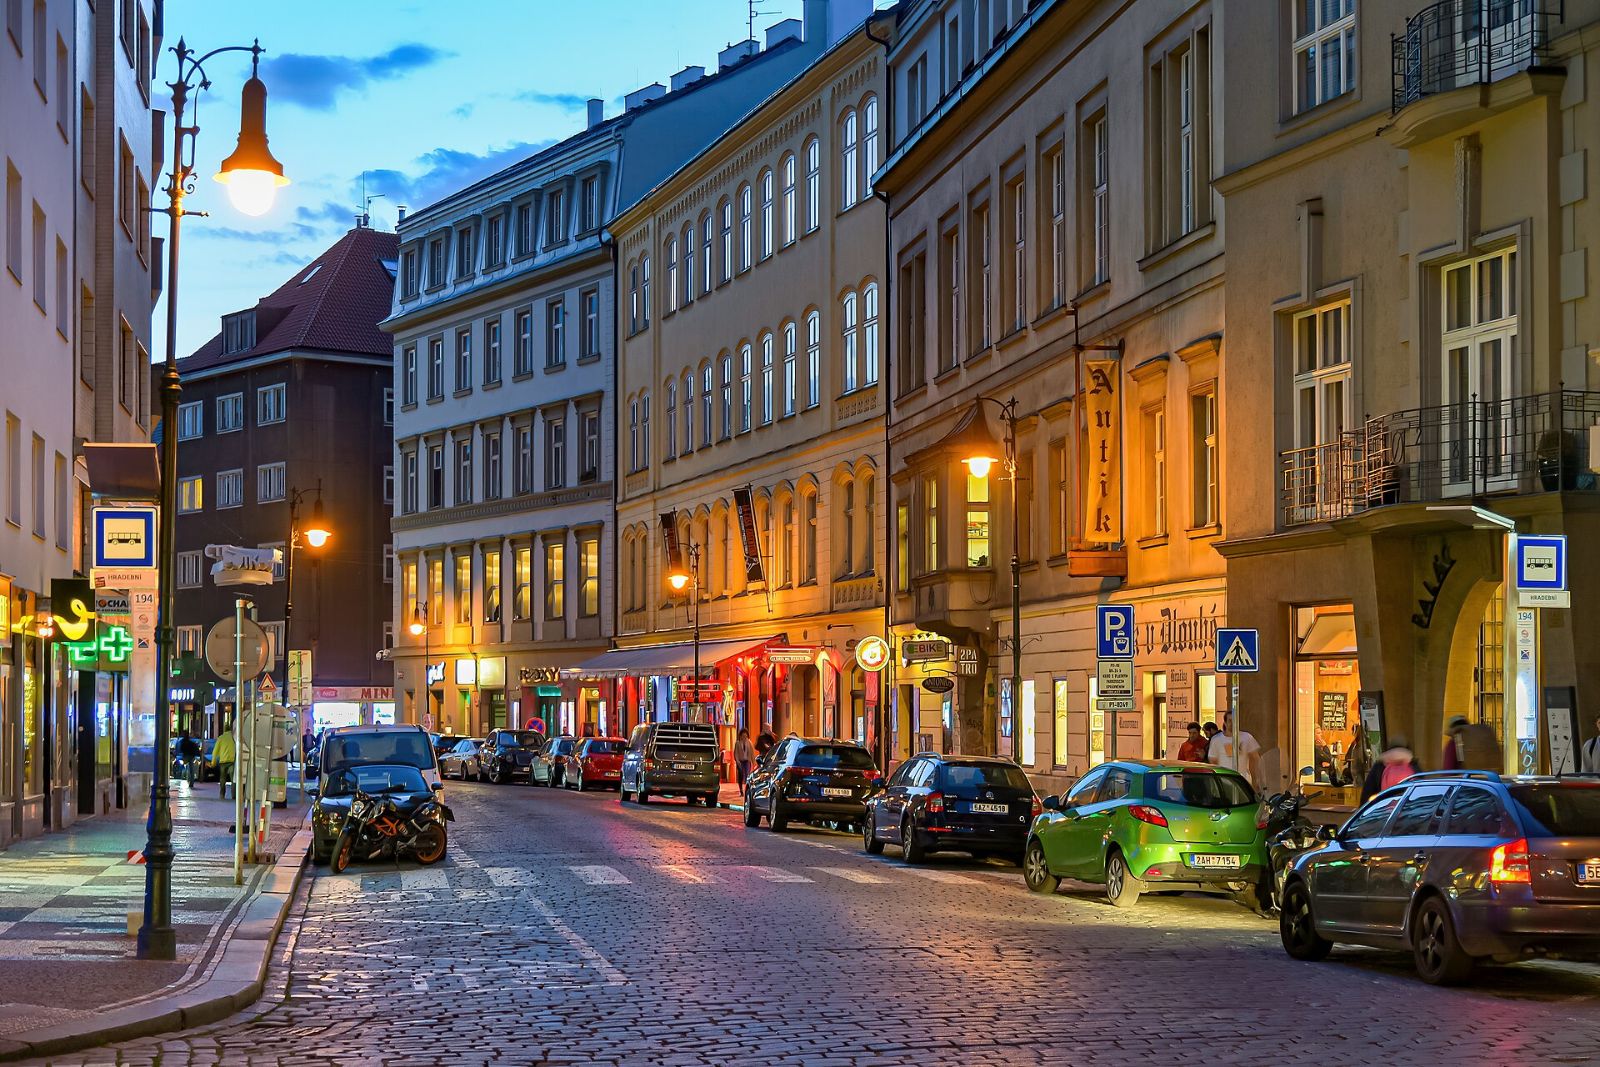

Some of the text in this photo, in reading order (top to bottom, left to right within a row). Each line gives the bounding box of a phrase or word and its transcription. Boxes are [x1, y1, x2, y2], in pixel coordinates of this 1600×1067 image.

[135, 594, 153, 603] 194
[1518, 612, 1532, 620] 194
[1105, 611, 1126, 641] P
[1196, 856, 1236, 865] 2AH 7154
